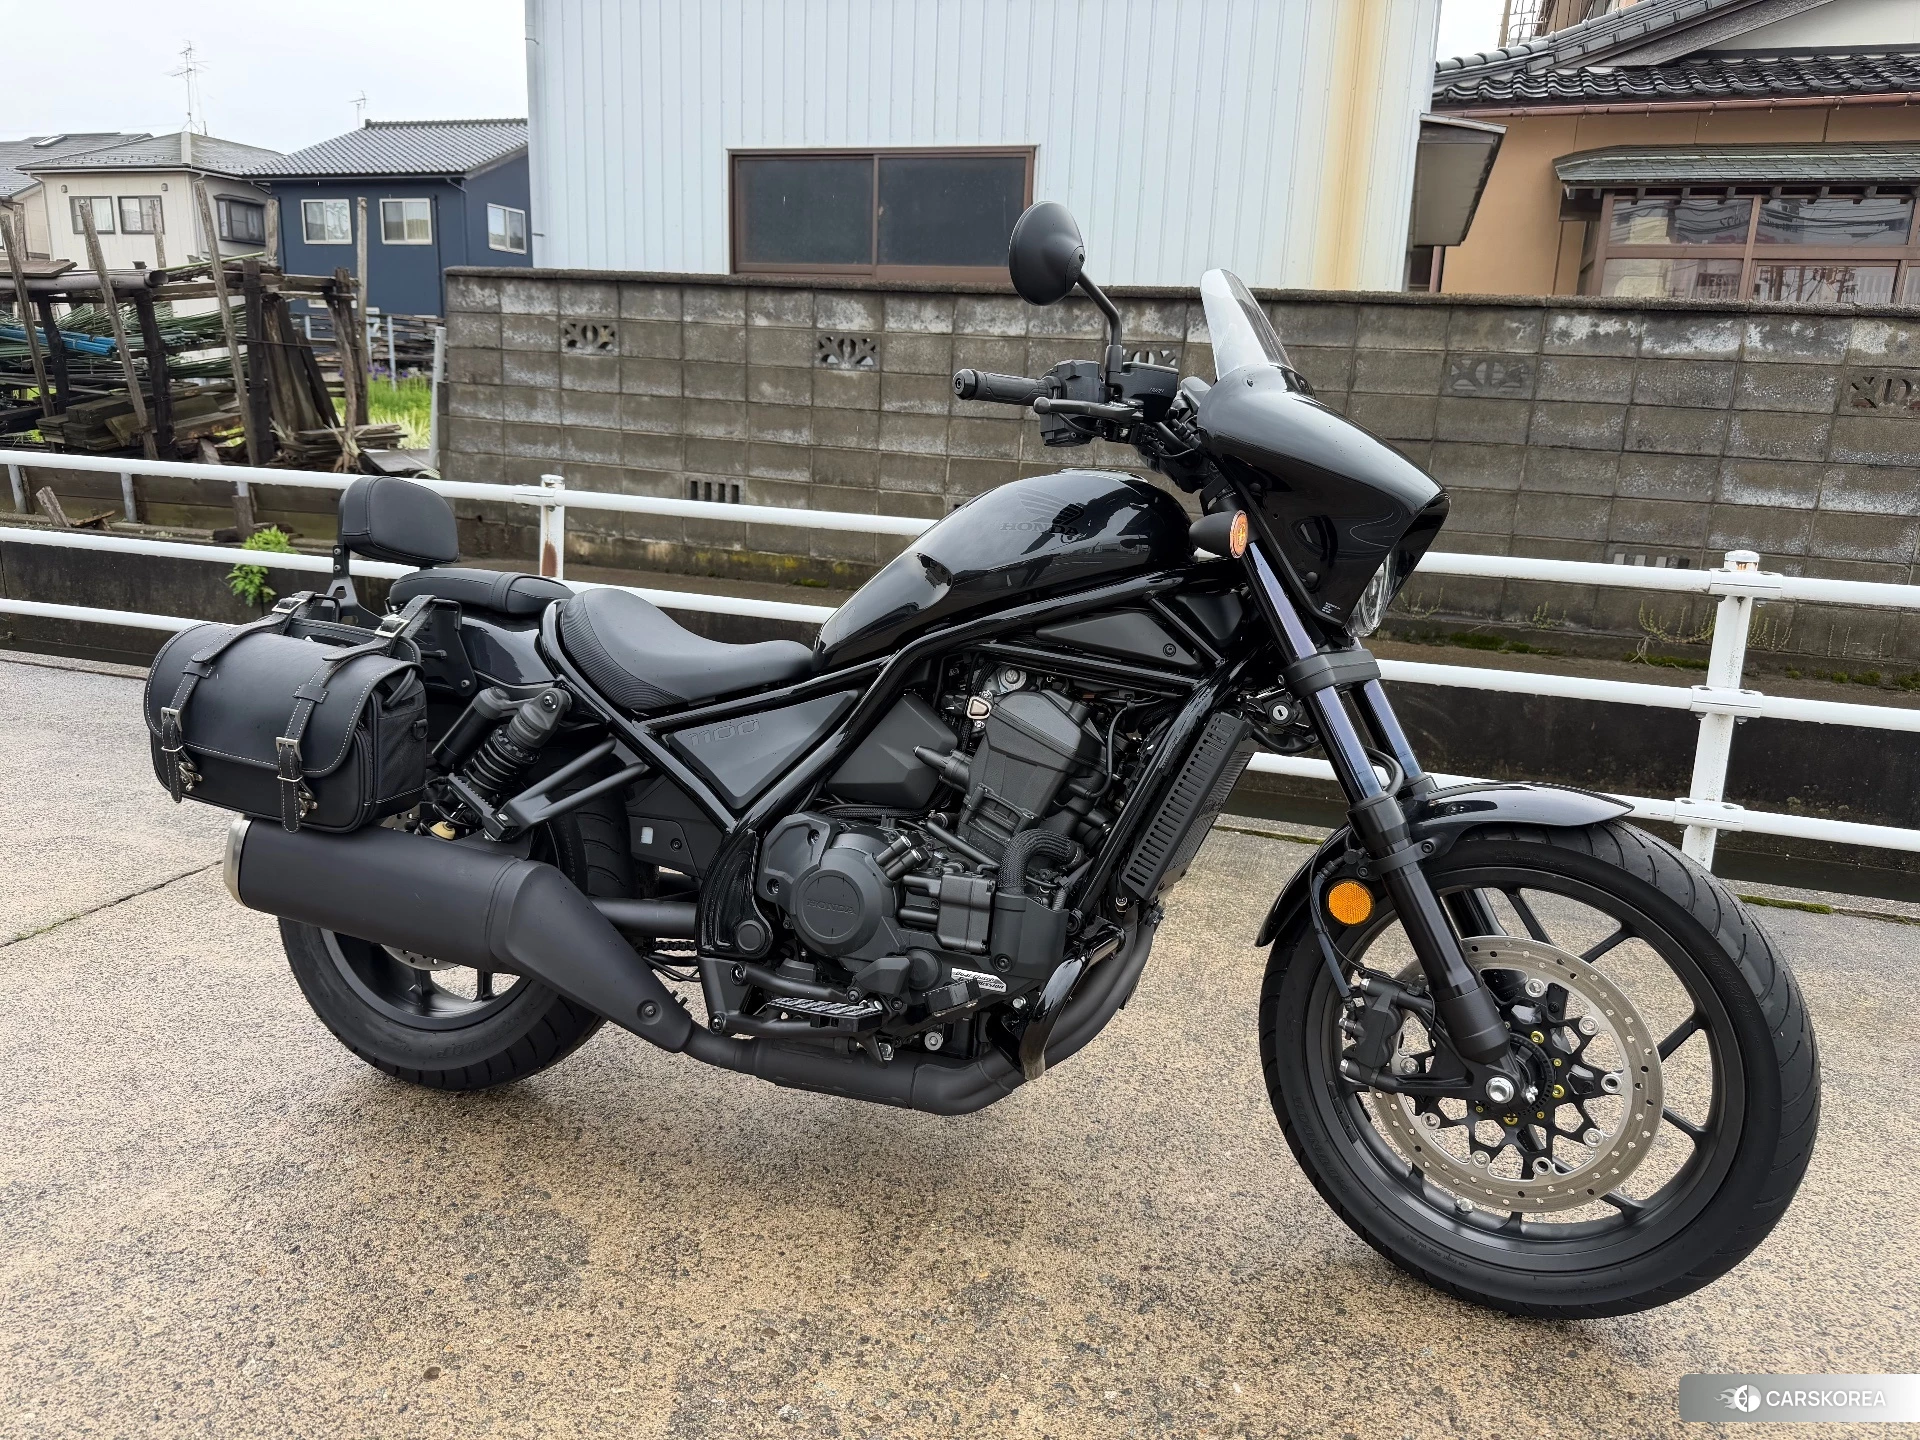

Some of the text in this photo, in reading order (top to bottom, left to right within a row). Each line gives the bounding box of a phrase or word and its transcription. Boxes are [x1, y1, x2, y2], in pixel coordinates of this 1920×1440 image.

[1000, 522, 1079, 536] HONDA
[687, 718, 760, 746] 1100
[806, 898, 856, 916] HONDA
